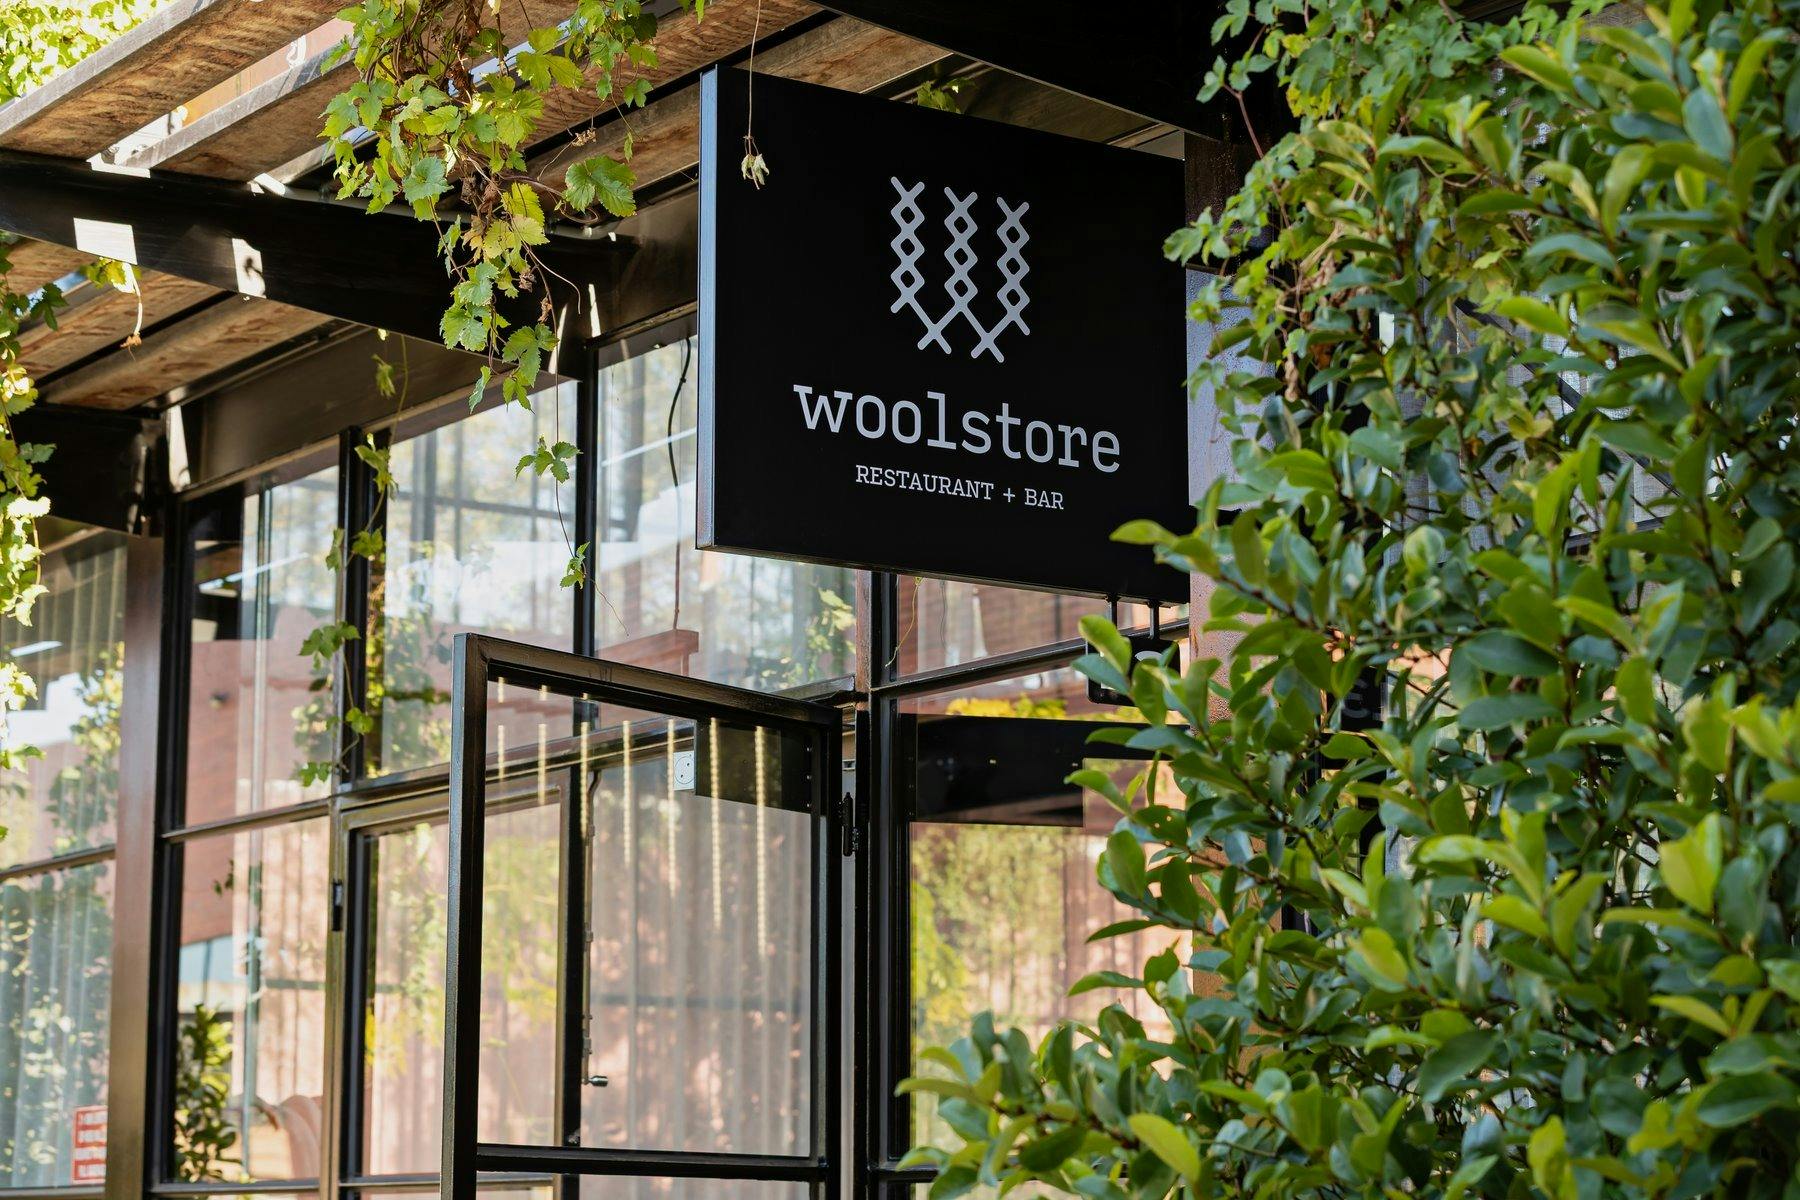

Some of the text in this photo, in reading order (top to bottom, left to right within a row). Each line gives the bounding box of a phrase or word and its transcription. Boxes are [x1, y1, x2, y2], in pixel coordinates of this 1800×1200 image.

[792, 384, 1120, 473] woolstore
[855, 464, 1065, 510] RESTAURANT + BAR
